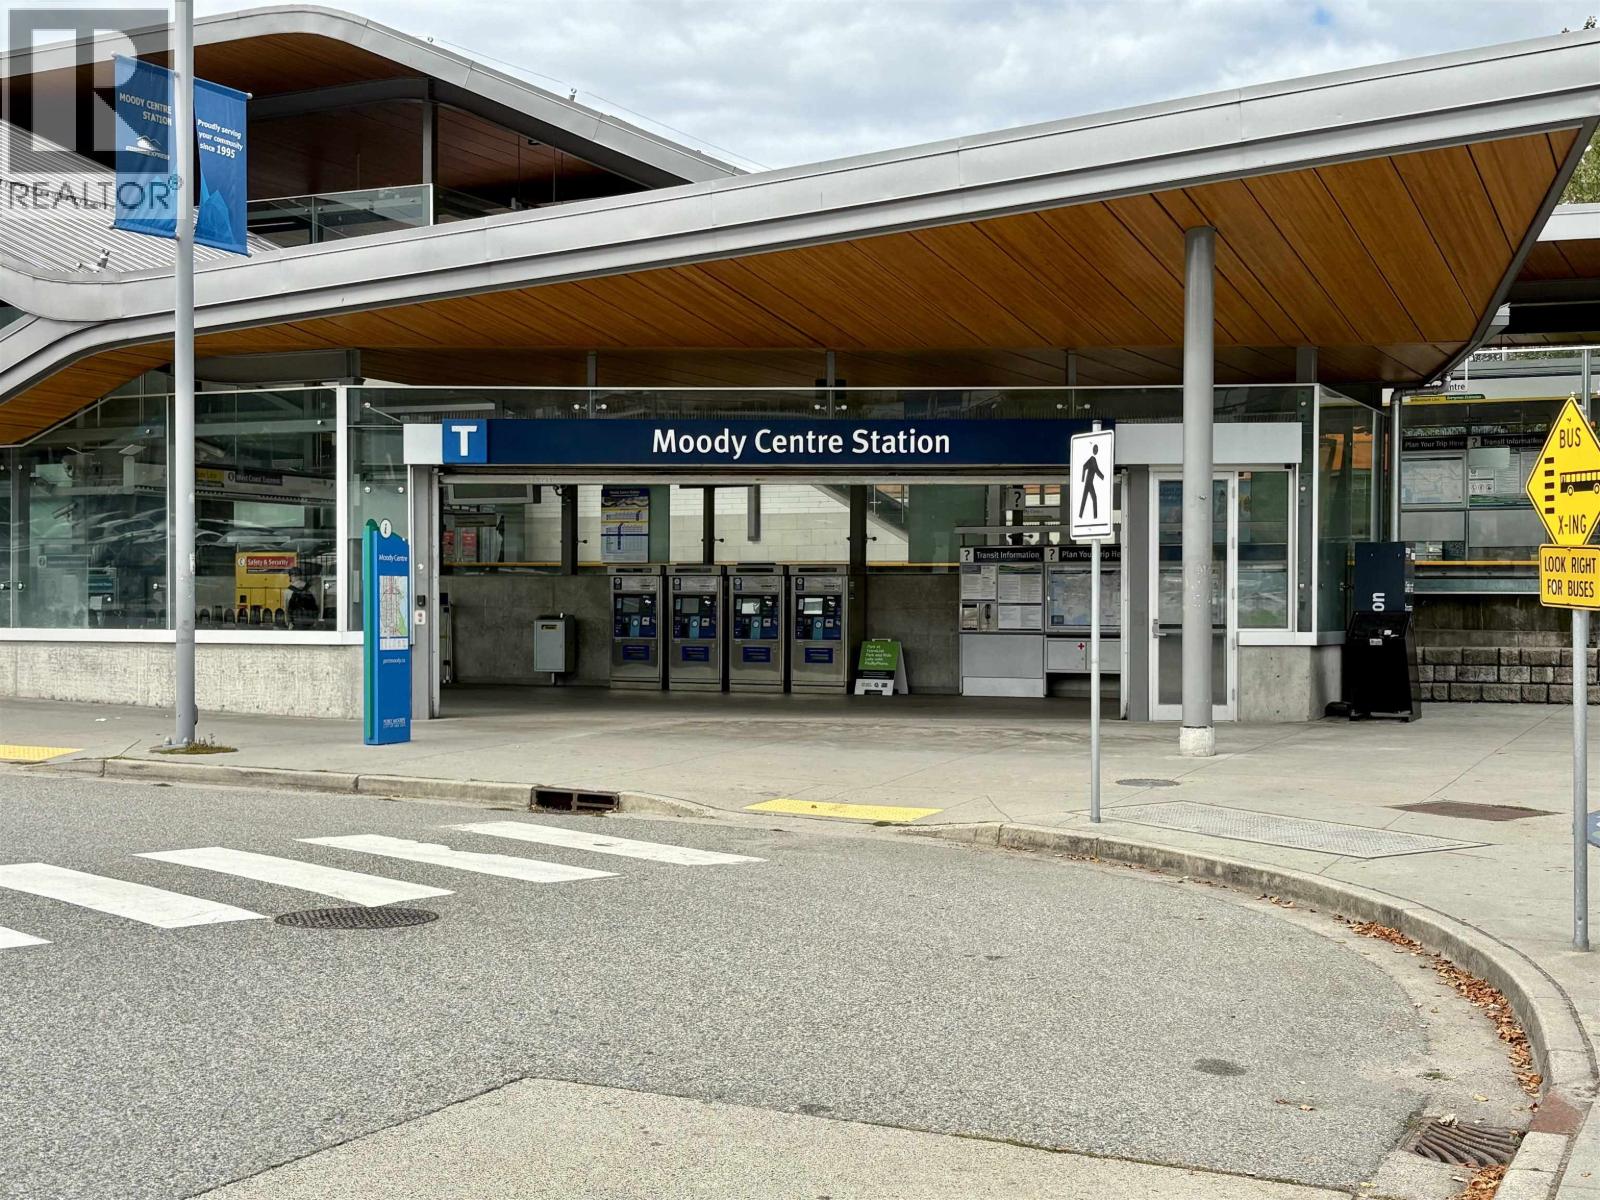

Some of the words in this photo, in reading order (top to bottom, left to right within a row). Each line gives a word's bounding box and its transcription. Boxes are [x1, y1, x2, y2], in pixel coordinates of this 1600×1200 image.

[119, 93, 145, 107] MOODY
[146, 100, 172, 115] CENTRE
[142, 111, 172, 127] STATION
[197, 119, 220, 133] Proudly
[221, 127, 242, 139] serving
[198, 132, 213, 140] your
[213, 136, 243, 151] community
[200, 143, 215, 152] since
[216, 145, 236, 159] 1995
[451, 425, 478, 457] T
[652, 428, 747, 460] Moody
[754, 428, 843, 454] Centre
[852, 428, 951, 454] Station
[1483, 438, 1505, 446] Transit
[1506, 437, 1544, 445] Information
[1559, 427, 1581, 448] BUS
[1558, 514, 1587, 535] X-ING
[247, 558, 263, 567] Safety
[268, 559, 289, 567] Security
[379, 554, 394, 562] Moody
[394, 554, 408, 562] Centre
[976, 551, 999, 559] Transit
[1000, 550, 1040, 559] Information
[1062, 550, 1078, 558] Plan
[1079, 550, 1092, 558] You
[1544, 556, 1567, 573] LOOK
[1571, 556, 1596, 574] RIGHT
[1547, 579, 1563, 595] FOR
[1567, 580, 1594, 598] BUSES
